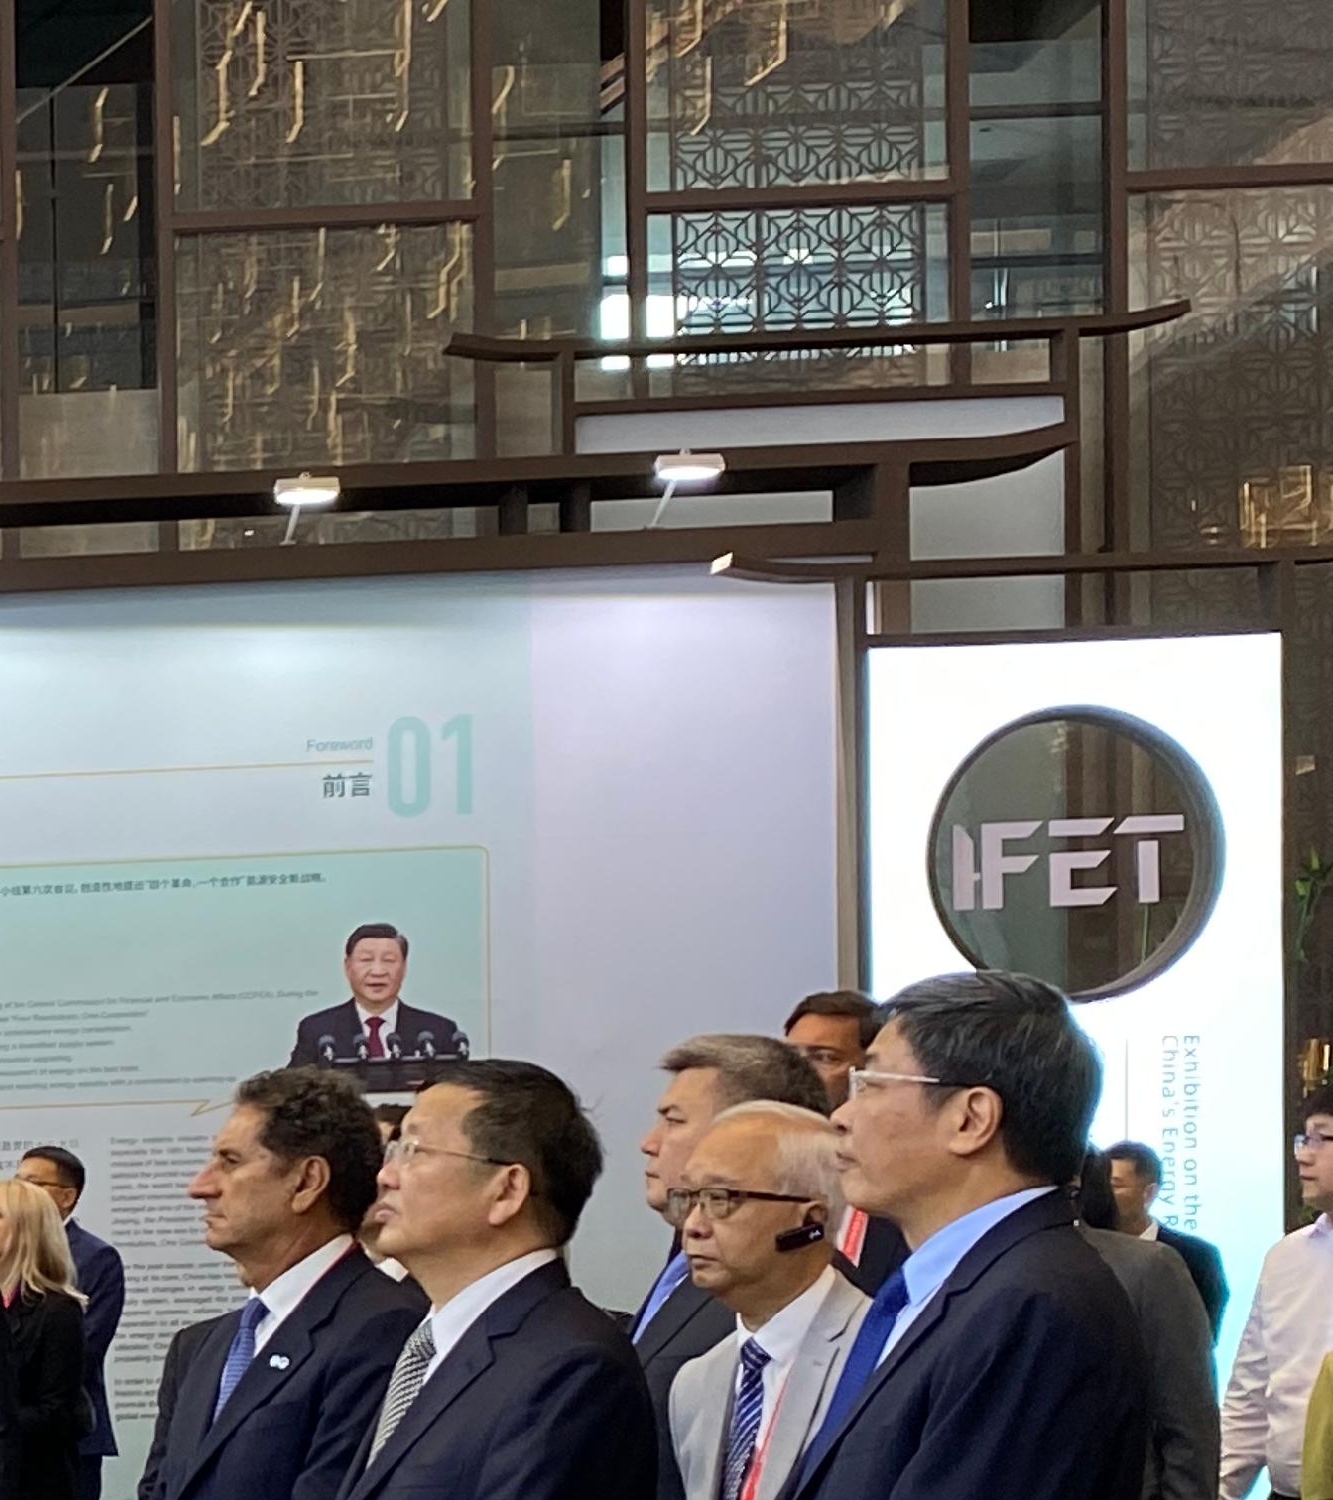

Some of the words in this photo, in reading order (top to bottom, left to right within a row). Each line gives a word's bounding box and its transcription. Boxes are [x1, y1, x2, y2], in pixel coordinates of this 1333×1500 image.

[306, 736, 373, 752] Foreword
[388, 714, 473, 817] 01
[322, 772, 373, 798] 前言
[953, 814, 1184, 911] IFET
[1161, 1034, 1179, 1118] China's
[1184, 1034, 1202, 1150] Exhibition
[1159, 1128, 1179, 1206] Energy
[1184, 1159, 1197, 1186] on
[1184, 1194, 1202, 1230] the
